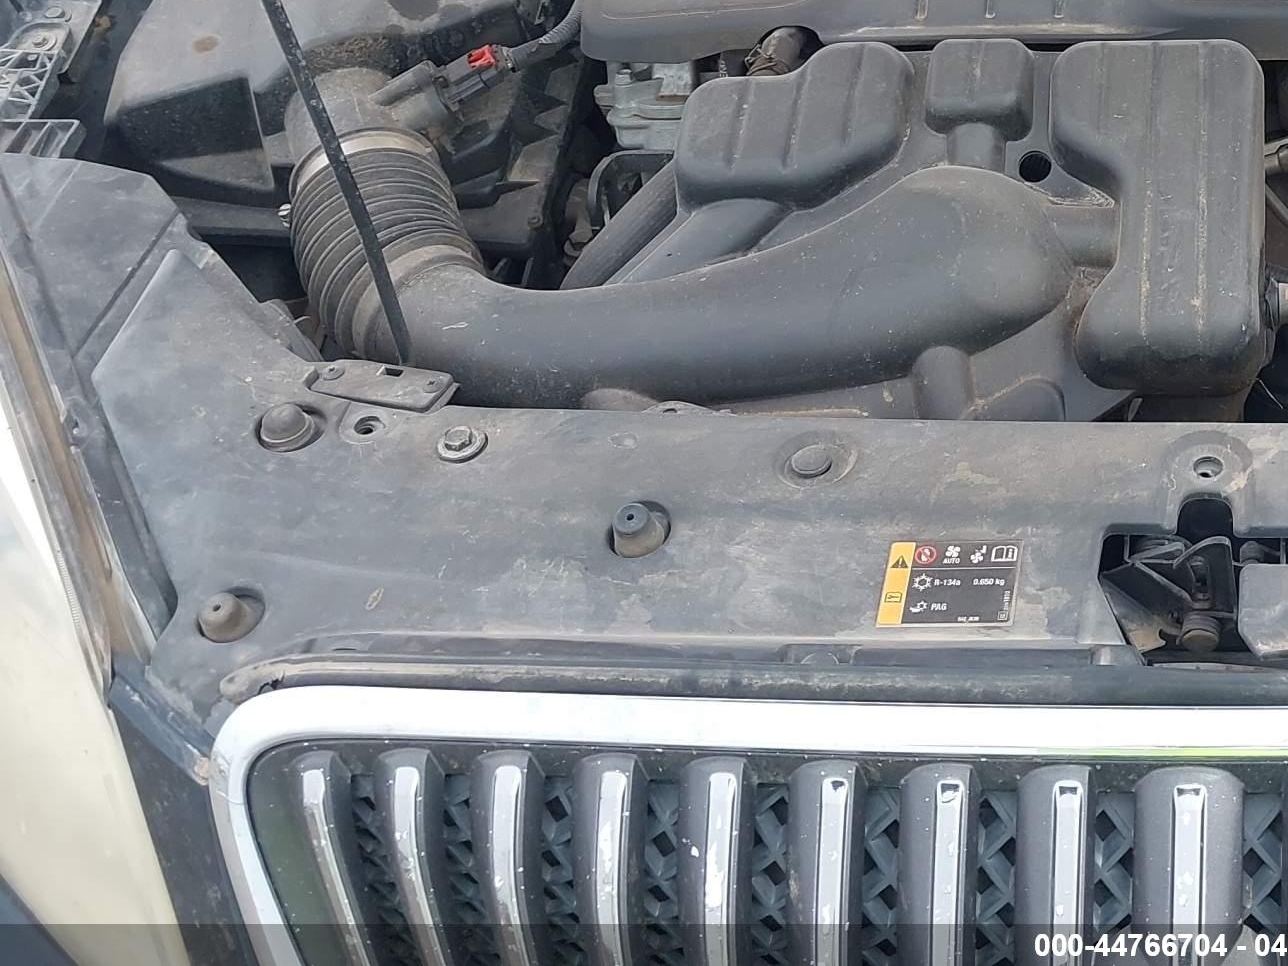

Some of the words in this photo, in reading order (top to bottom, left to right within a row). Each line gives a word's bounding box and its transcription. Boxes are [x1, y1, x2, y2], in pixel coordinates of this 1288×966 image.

[933, 578, 961, 586] R-134a
[994, 578, 1005, 586] kg
[930, 602, 948, 611] PAG
